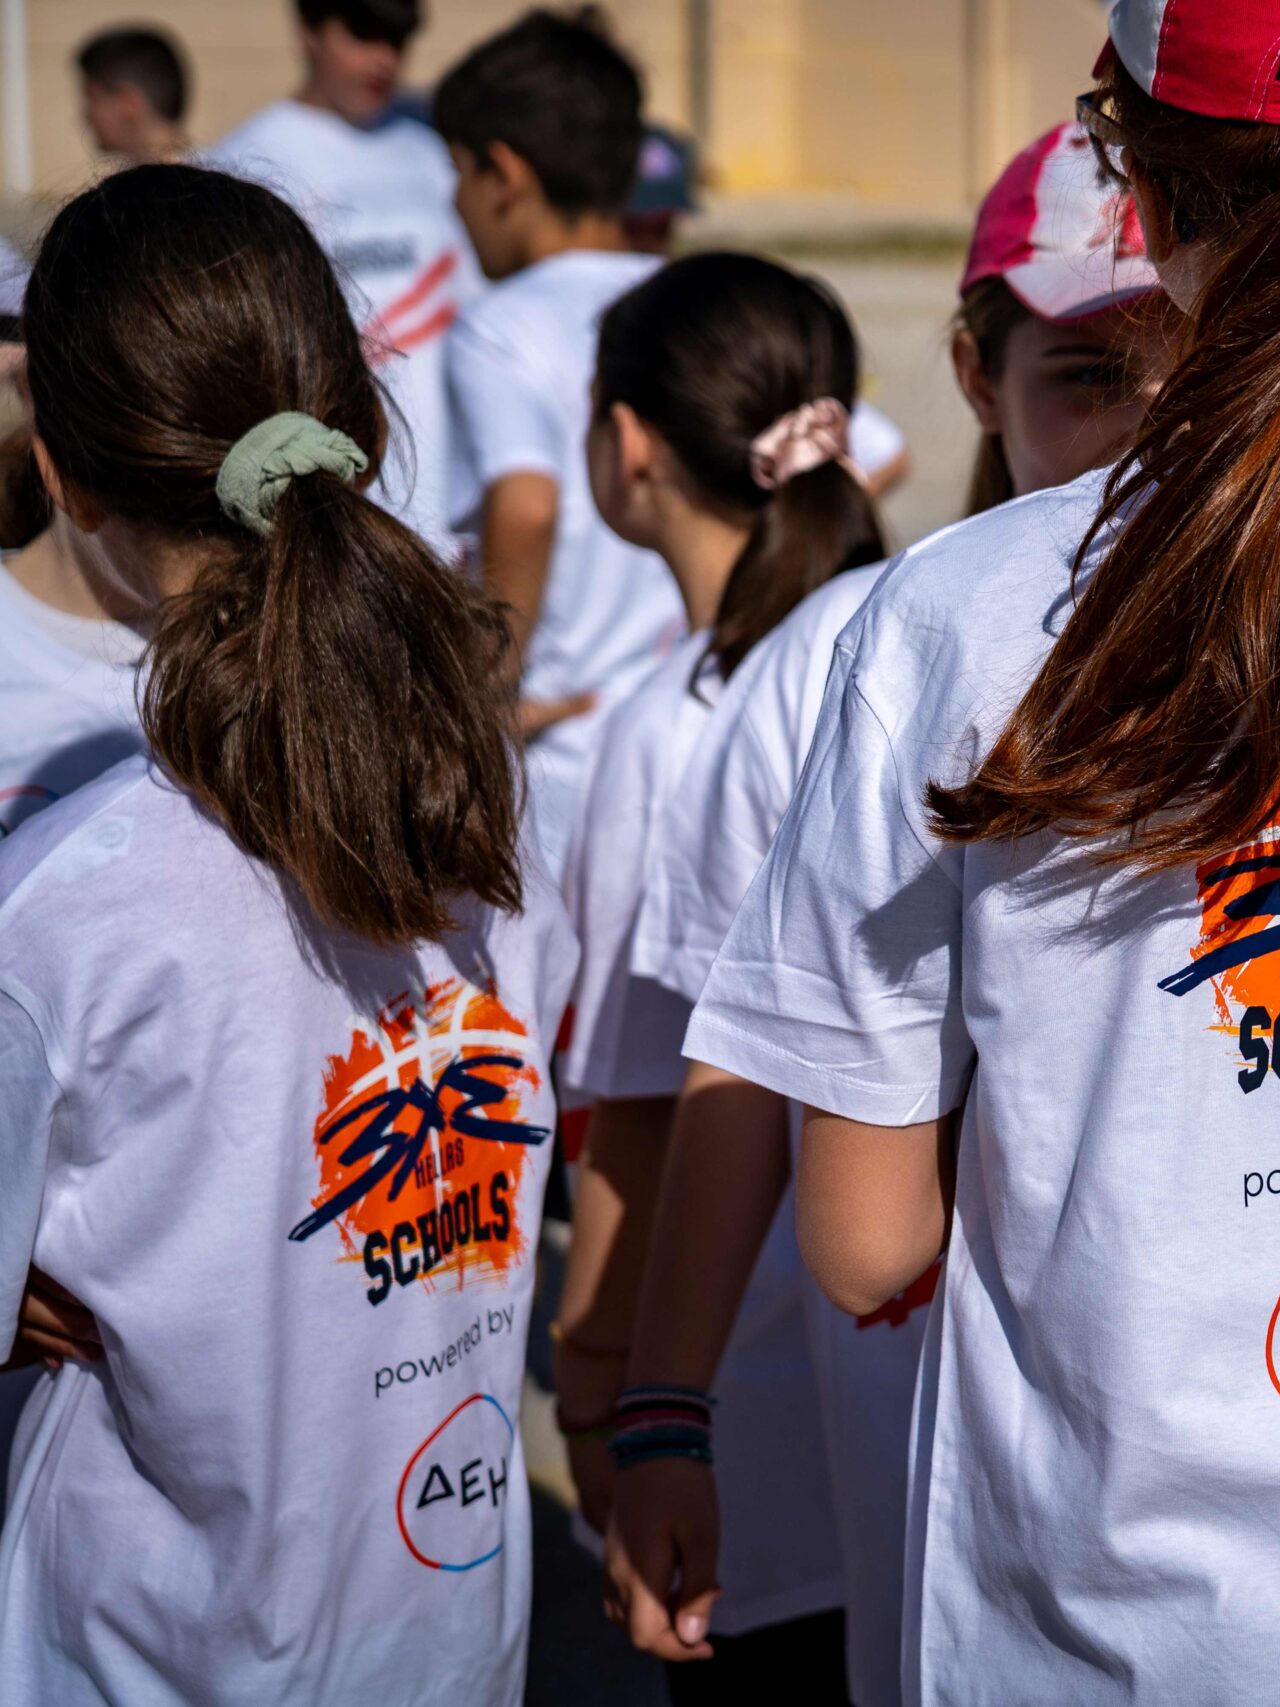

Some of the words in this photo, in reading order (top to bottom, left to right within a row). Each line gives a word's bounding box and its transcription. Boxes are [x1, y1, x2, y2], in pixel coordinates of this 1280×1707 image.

[413, 1138, 465, 1188] HELLAS
[363, 1171, 510, 1306] SCHOOLS
[374, 1316, 482, 1397] powered
[487, 1304, 515, 1336] by
